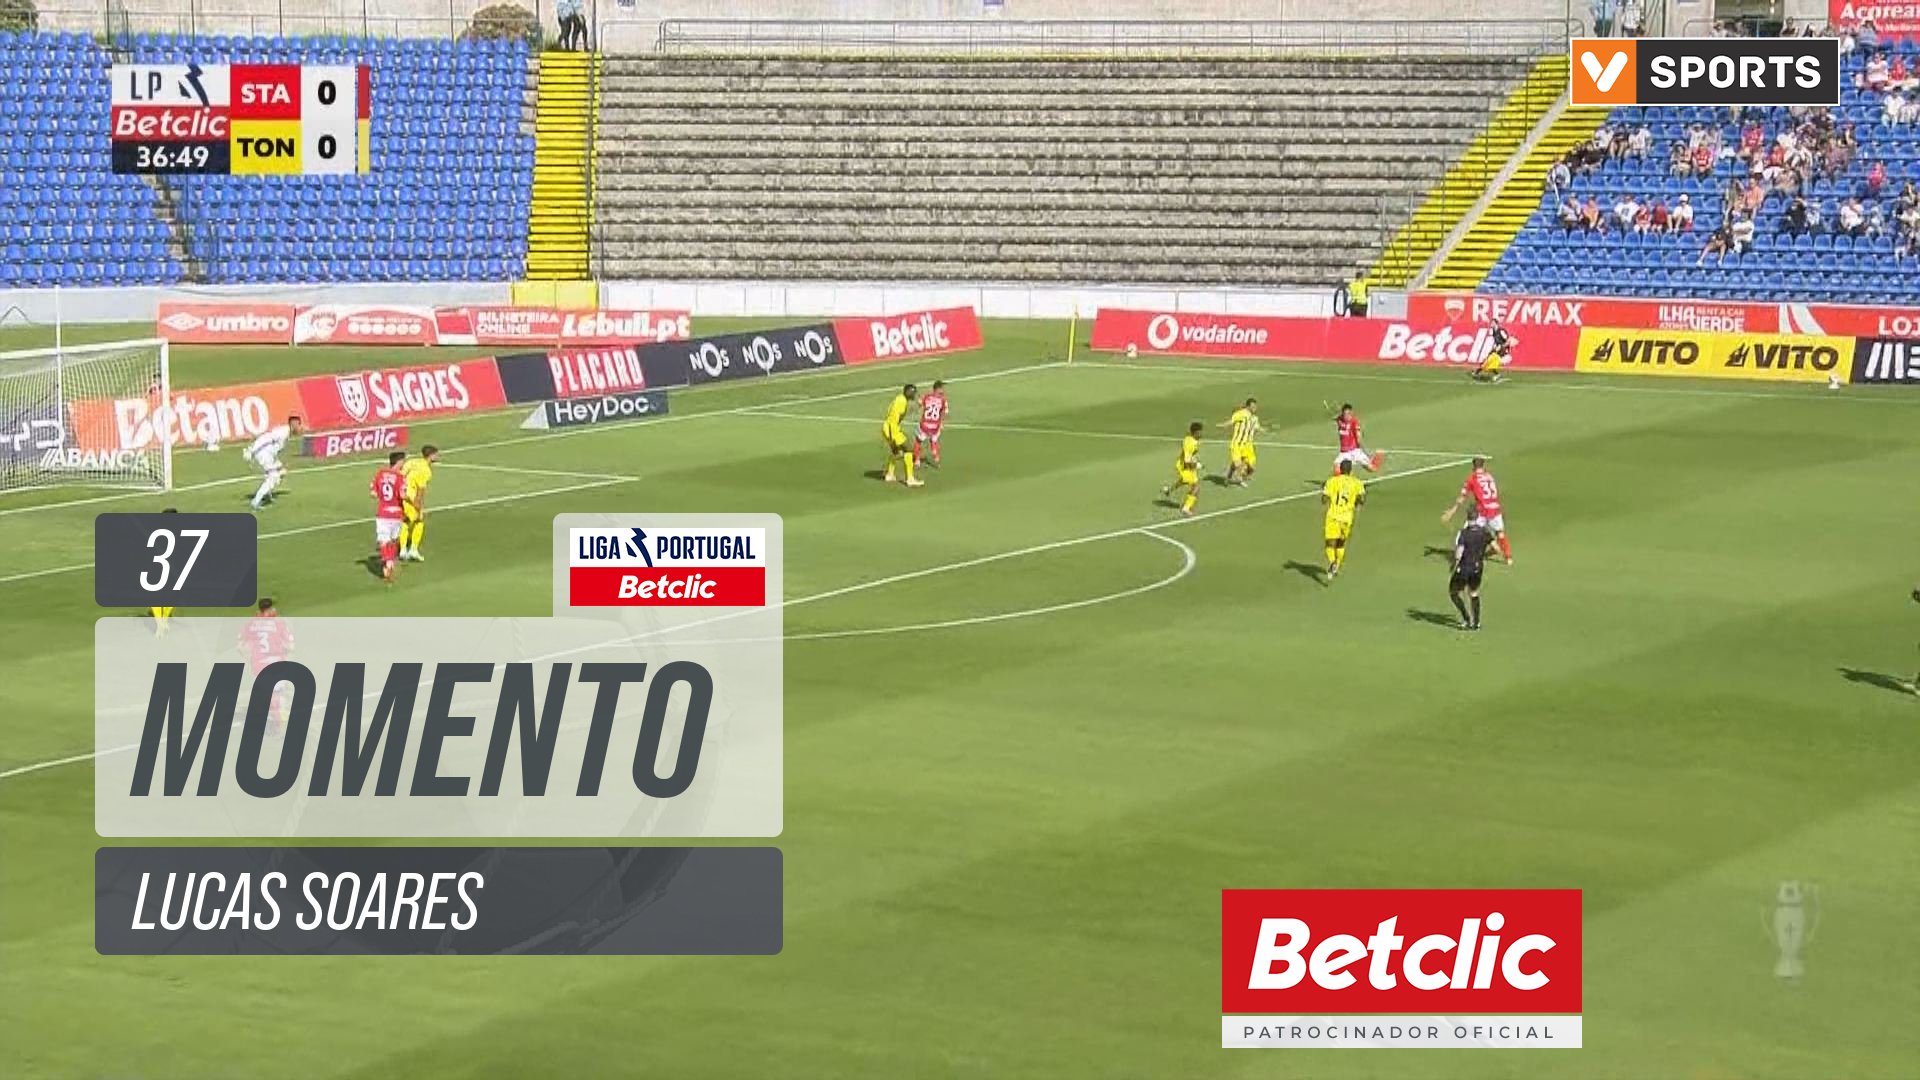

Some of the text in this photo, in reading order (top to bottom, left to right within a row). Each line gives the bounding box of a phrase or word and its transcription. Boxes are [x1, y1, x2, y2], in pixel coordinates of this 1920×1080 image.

[207, 313, 289, 332] umbro
[1472, 298, 1583, 326] RE/MAX
[793, 331, 834, 364] NOS
[870, 313, 950, 357] Betclic
[1182, 324, 1268, 344] vodafone
[688, 342, 730, 377] NOS
[742, 335, 783, 370] NOS
[1619, 338, 1699, 365] VITO
[1753, 343, 1839, 371] VITO
[548, 349, 644, 394] PLACARD
[368, 365, 470, 418] SAGRES
[114, 395, 269, 449] Betano
[326, 428, 397, 457] Betclic
[382, 483, 393, 501] 9
